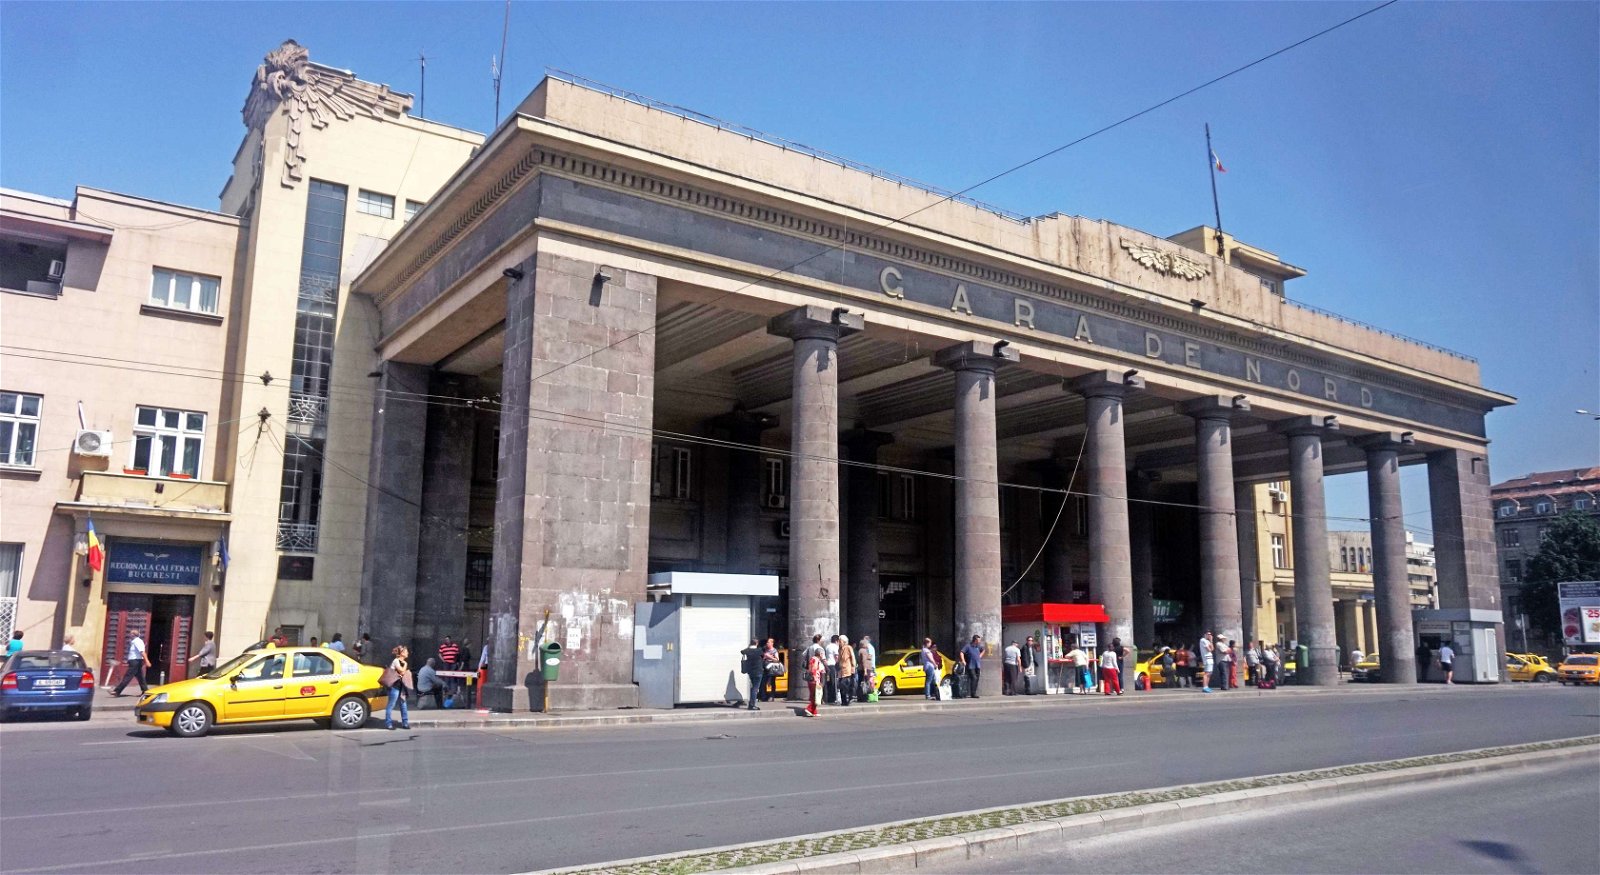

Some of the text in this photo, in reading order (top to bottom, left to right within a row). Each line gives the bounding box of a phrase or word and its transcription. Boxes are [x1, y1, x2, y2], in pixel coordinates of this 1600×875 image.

[880, 266, 1373, 408] GARA DE NORD
[128, 571, 180, 579] BUCURESTI
